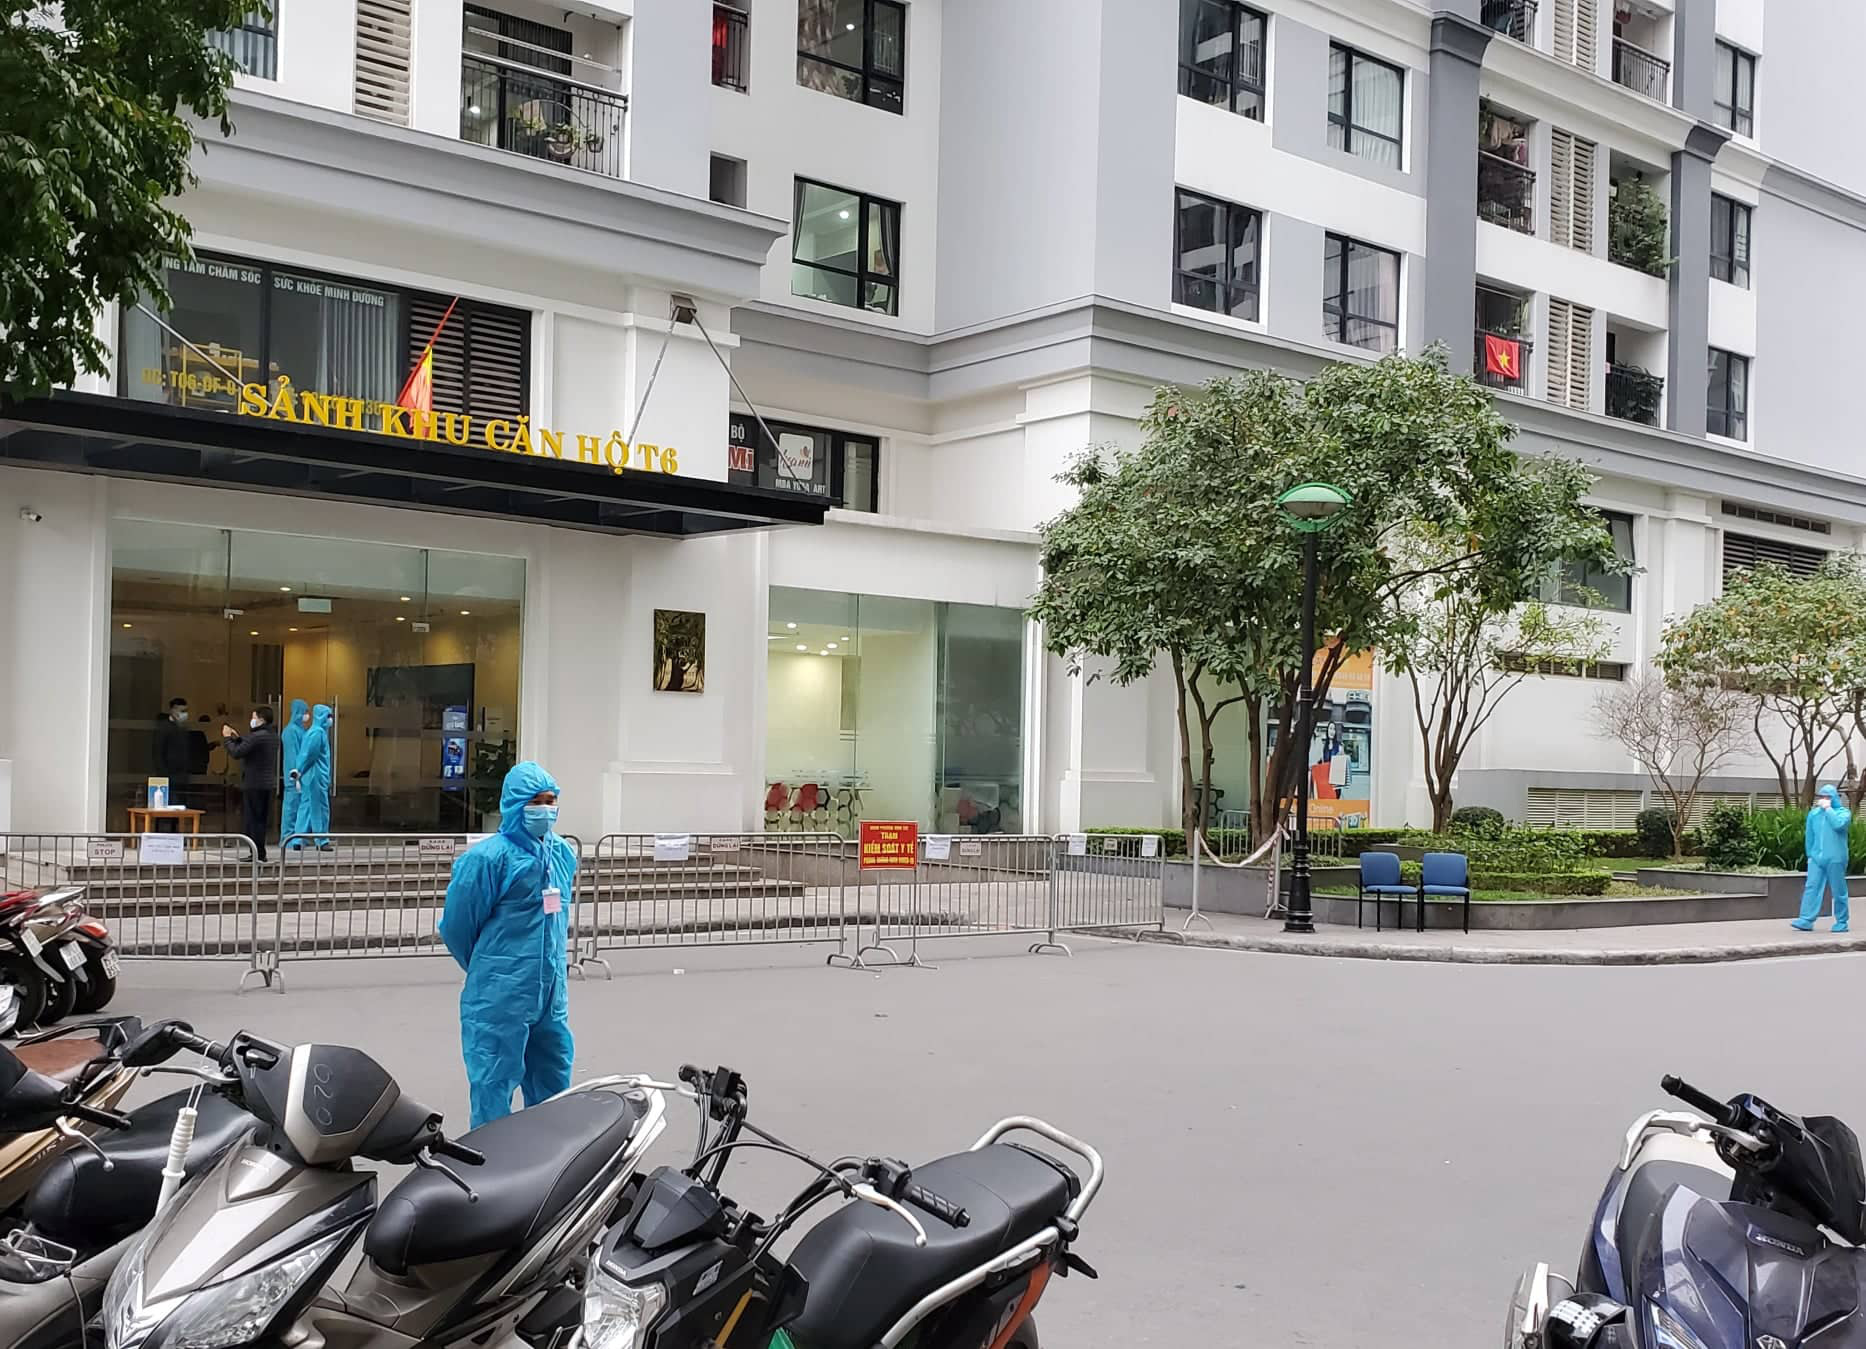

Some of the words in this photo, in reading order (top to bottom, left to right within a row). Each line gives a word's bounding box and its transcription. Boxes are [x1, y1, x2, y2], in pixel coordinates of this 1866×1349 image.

[324, 286, 350, 301] MINH
[241, 374, 365, 431] SẢNH
[379, 402, 473, 446] KHU
[484, 414, 565, 461] CĂN
[575, 429, 630, 476] HỘ
[636, 442, 679, 475] T6
[730, 423, 745, 443] BỘ
[94, 848, 116, 856] STOP
